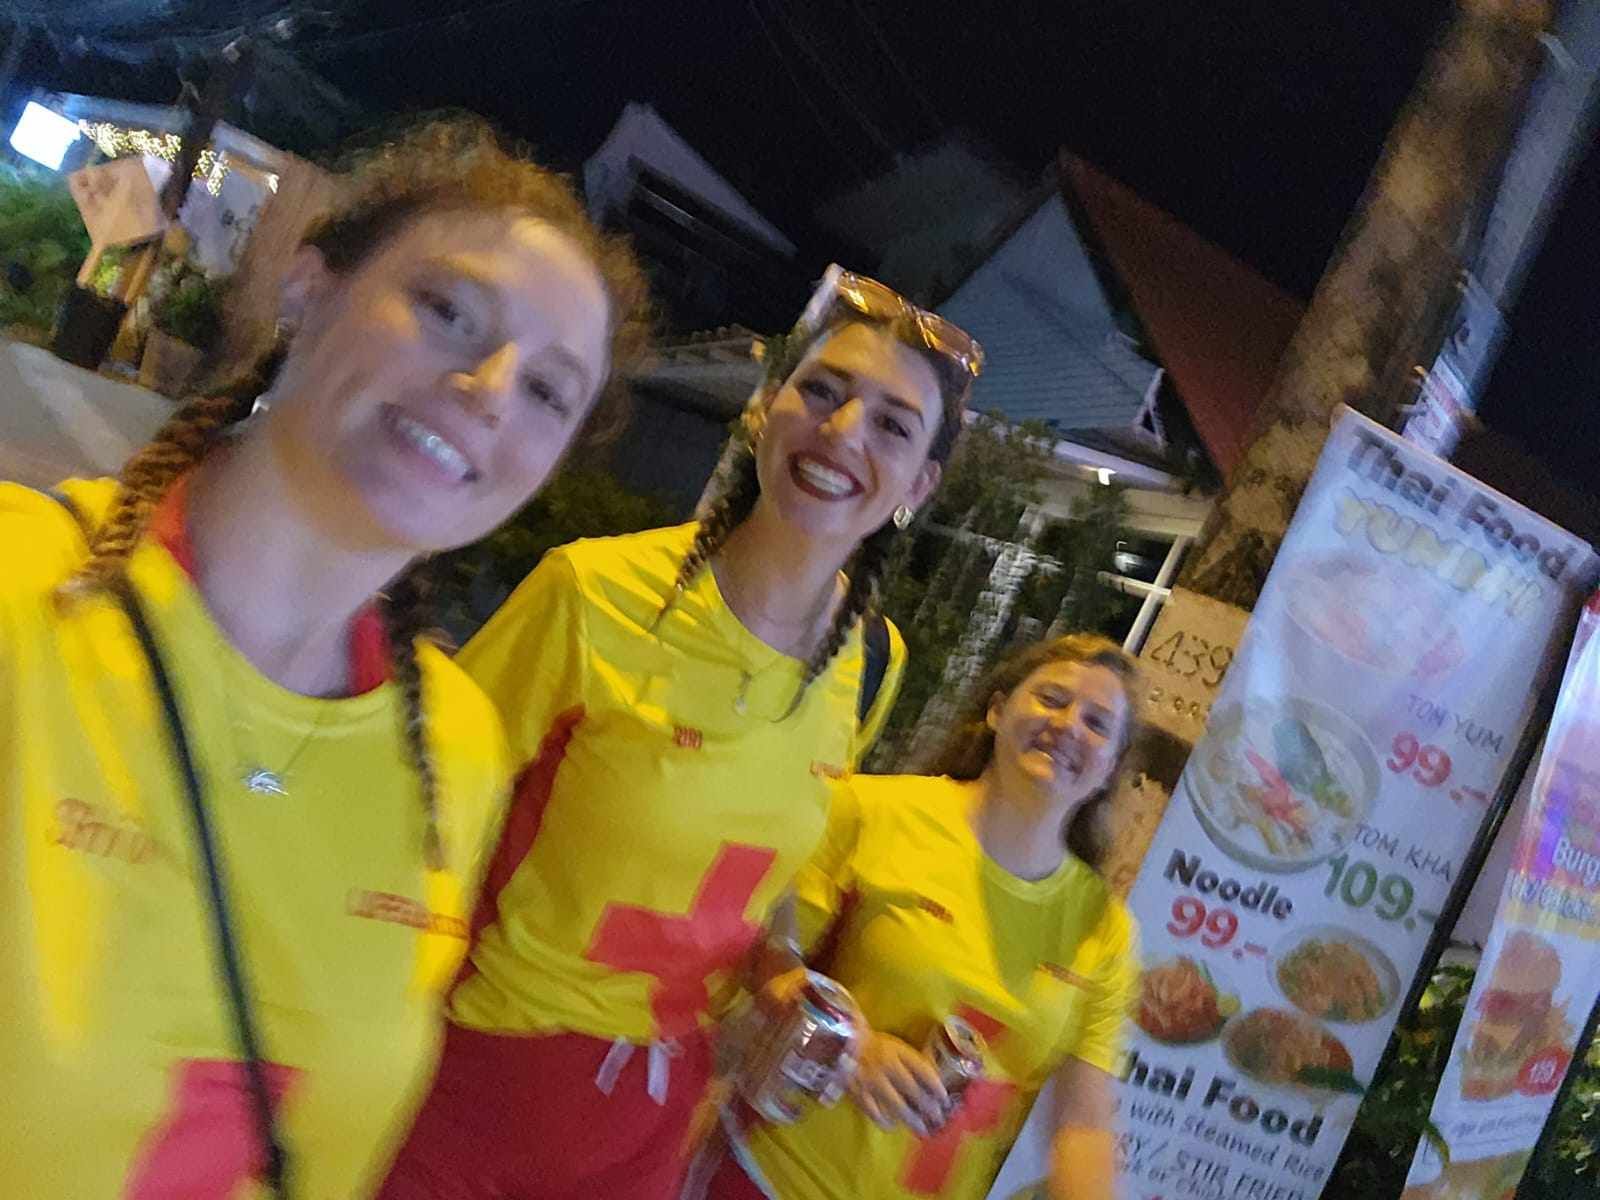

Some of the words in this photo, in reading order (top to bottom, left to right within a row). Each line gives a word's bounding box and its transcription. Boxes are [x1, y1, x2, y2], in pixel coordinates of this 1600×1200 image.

[1347, 424, 1459, 516] Thai
[1456, 491, 1577, 584] Food
[1150, 630, 1233, 688] 439
[1408, 693, 1448, 727] TOM
[1453, 713, 1504, 753] YUM
[1354, 822, 1399, 858] TOM
[1404, 844, 1450, 883] KHA
[1163, 848, 1293, 920] Noodle
[1119, 1050, 1196, 1101] hai
[1202, 1073, 1325, 1147] Food
[1283, 1152, 1326, 1184] Rice
